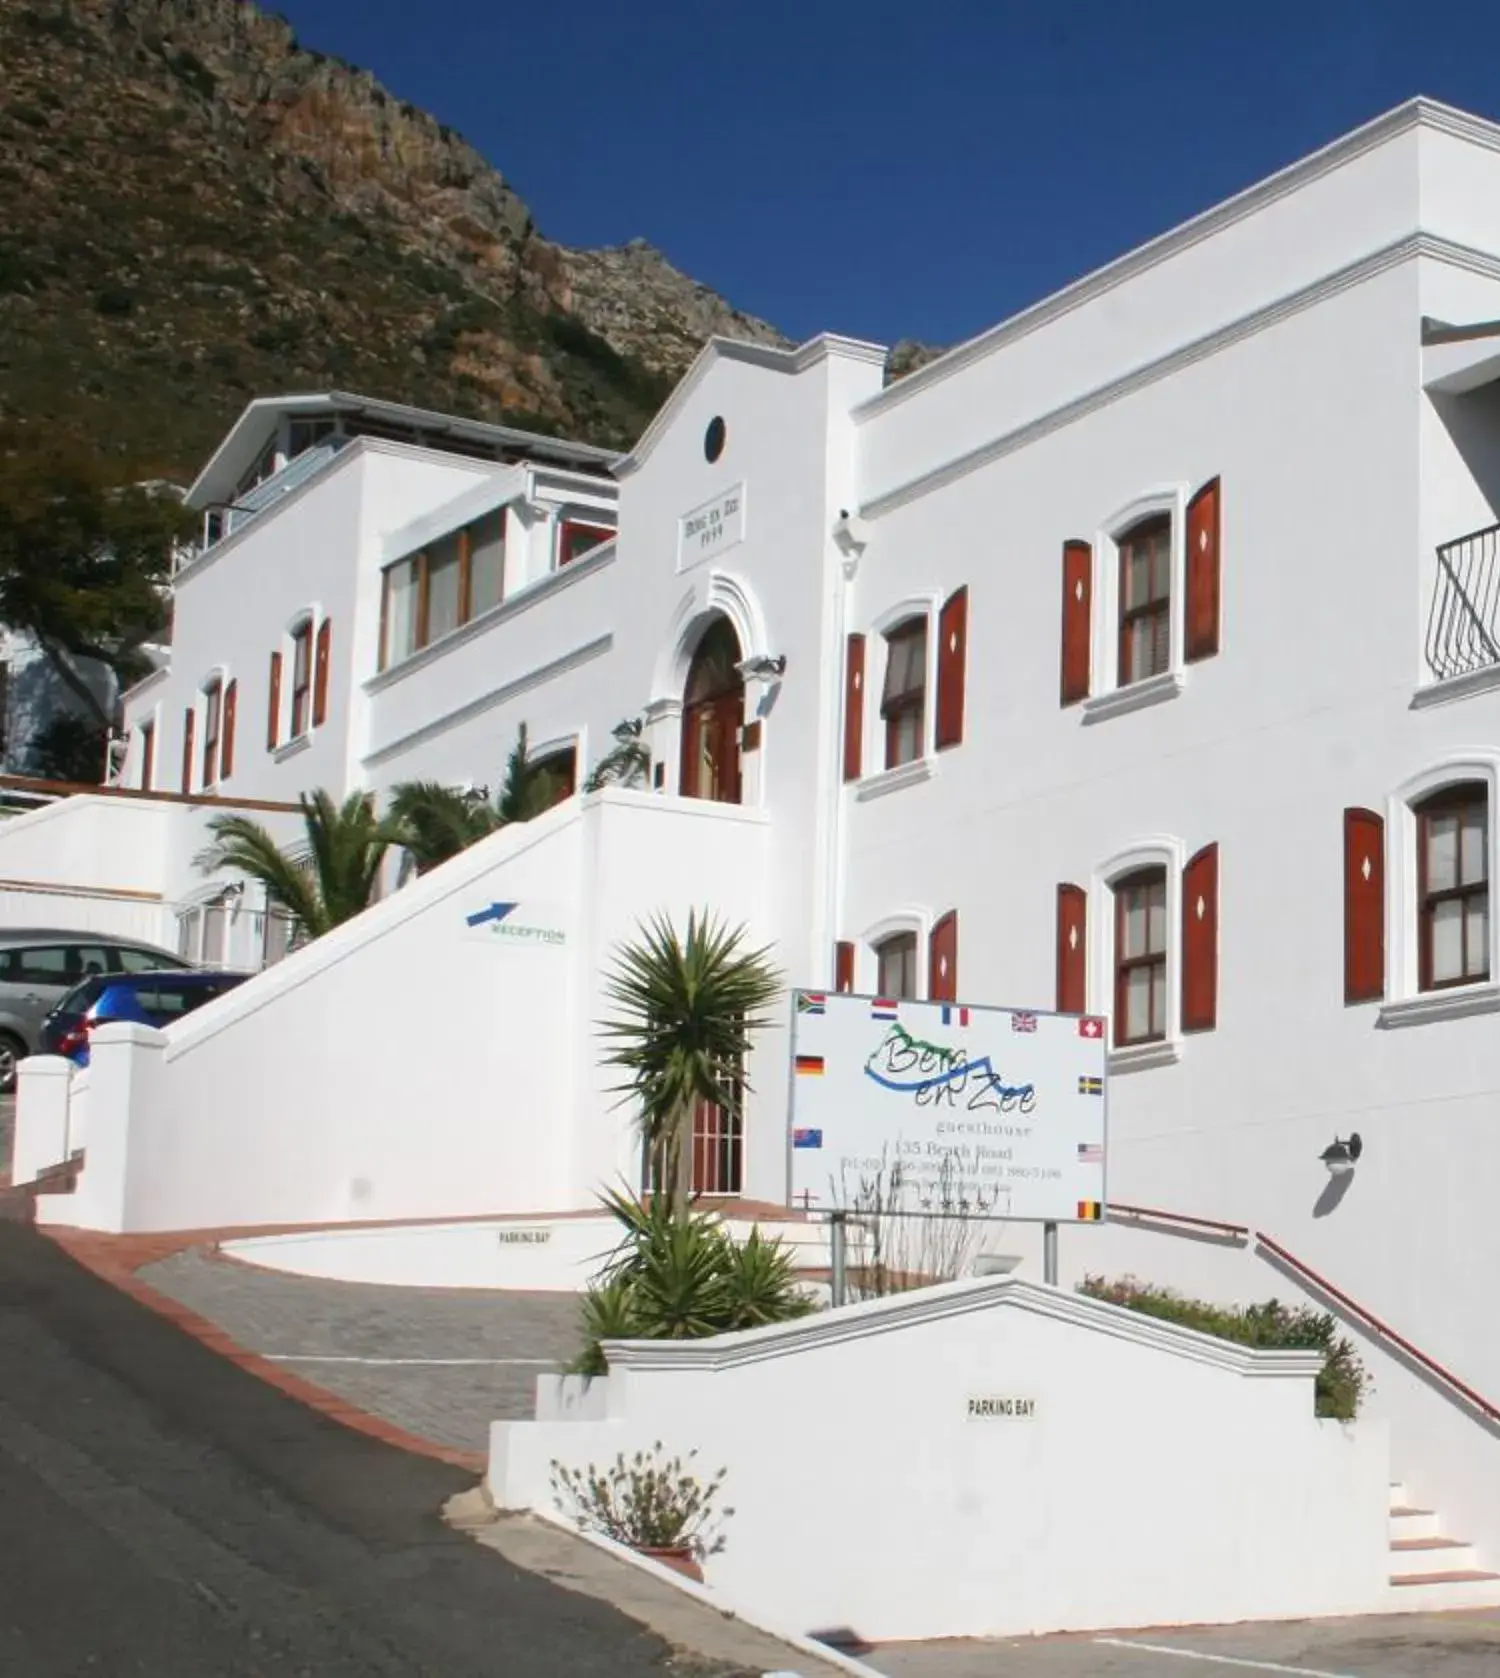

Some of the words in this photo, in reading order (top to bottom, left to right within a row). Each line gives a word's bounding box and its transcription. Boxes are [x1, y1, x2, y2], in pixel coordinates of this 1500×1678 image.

[492, 923, 566, 943] RECEPTION
[885, 1033, 968, 1093] Berg
[915, 1081, 956, 1107] en
[968, 1073, 1037, 1113] Zee
[936, 1120, 1033, 1139] guesthouse
[976, 1143, 1013, 1161] Road
[968, 1399, 1013, 1416] PARKING
[1015, 1399, 1034, 1416] BAY
